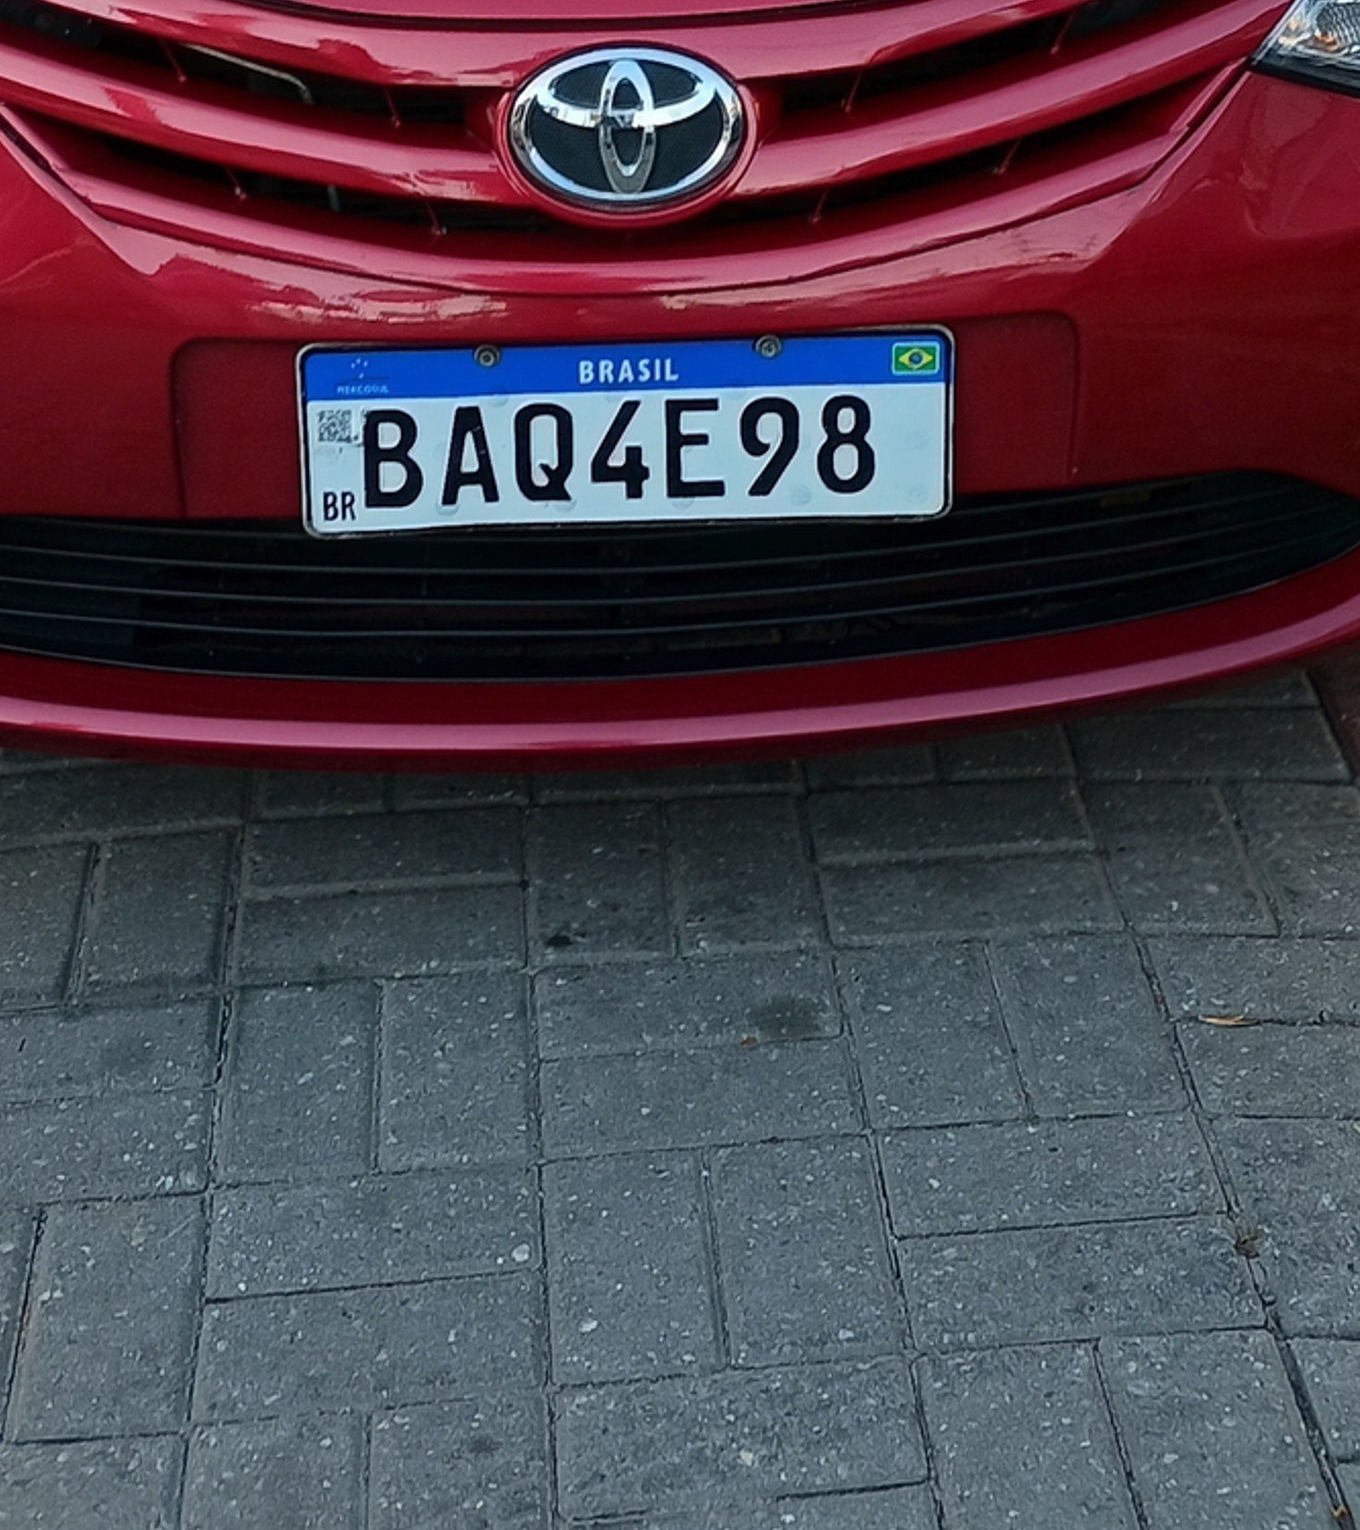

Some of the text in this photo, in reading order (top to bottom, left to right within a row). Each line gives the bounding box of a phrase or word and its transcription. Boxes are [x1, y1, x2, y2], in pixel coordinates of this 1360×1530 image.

[578, 358, 679, 384] BRASIL
[336, 383, 389, 394] MERCOSUL
[363, 394, 877, 509] BAQ4E98
[322, 490, 357, 522] BR
